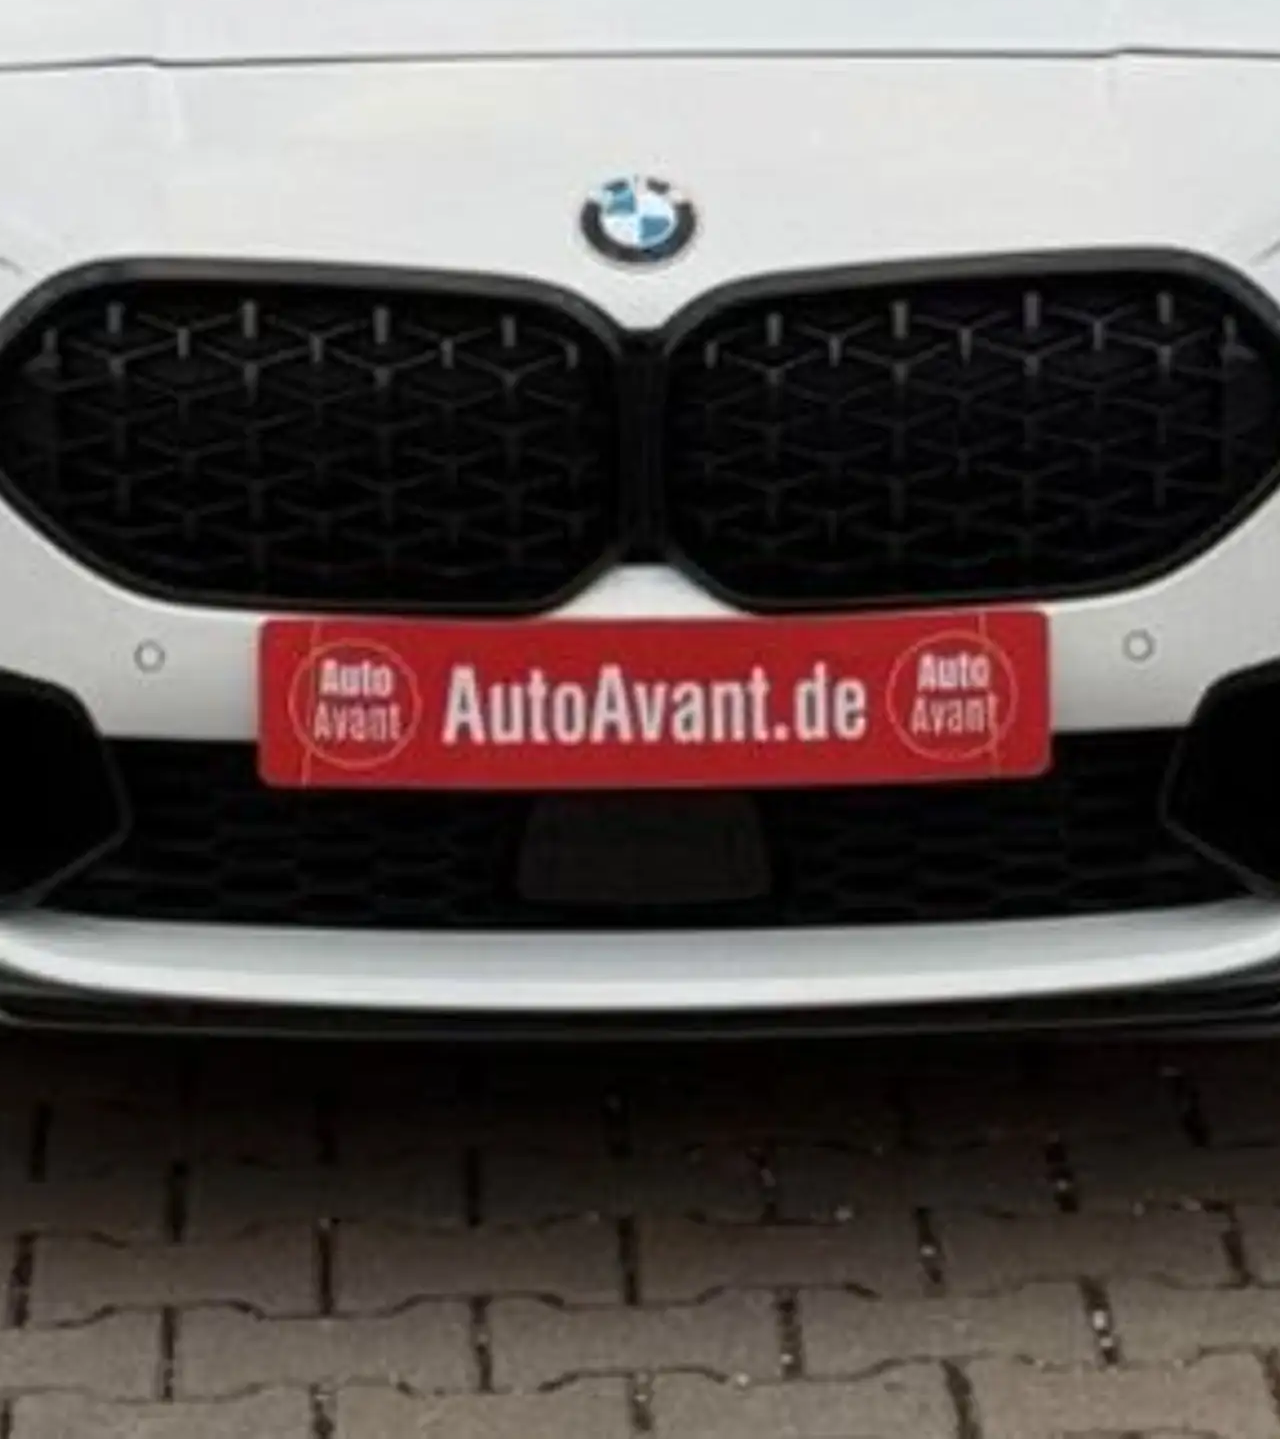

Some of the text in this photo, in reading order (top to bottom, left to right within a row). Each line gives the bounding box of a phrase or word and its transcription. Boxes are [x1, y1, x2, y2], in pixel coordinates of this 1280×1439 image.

[320, 659, 394, 697] Auto
[917, 652, 991, 689] Auto
[314, 702, 403, 742] Avant
[441, 661, 868, 745] AutoAvant.de
[911, 692, 1000, 737] Avant
